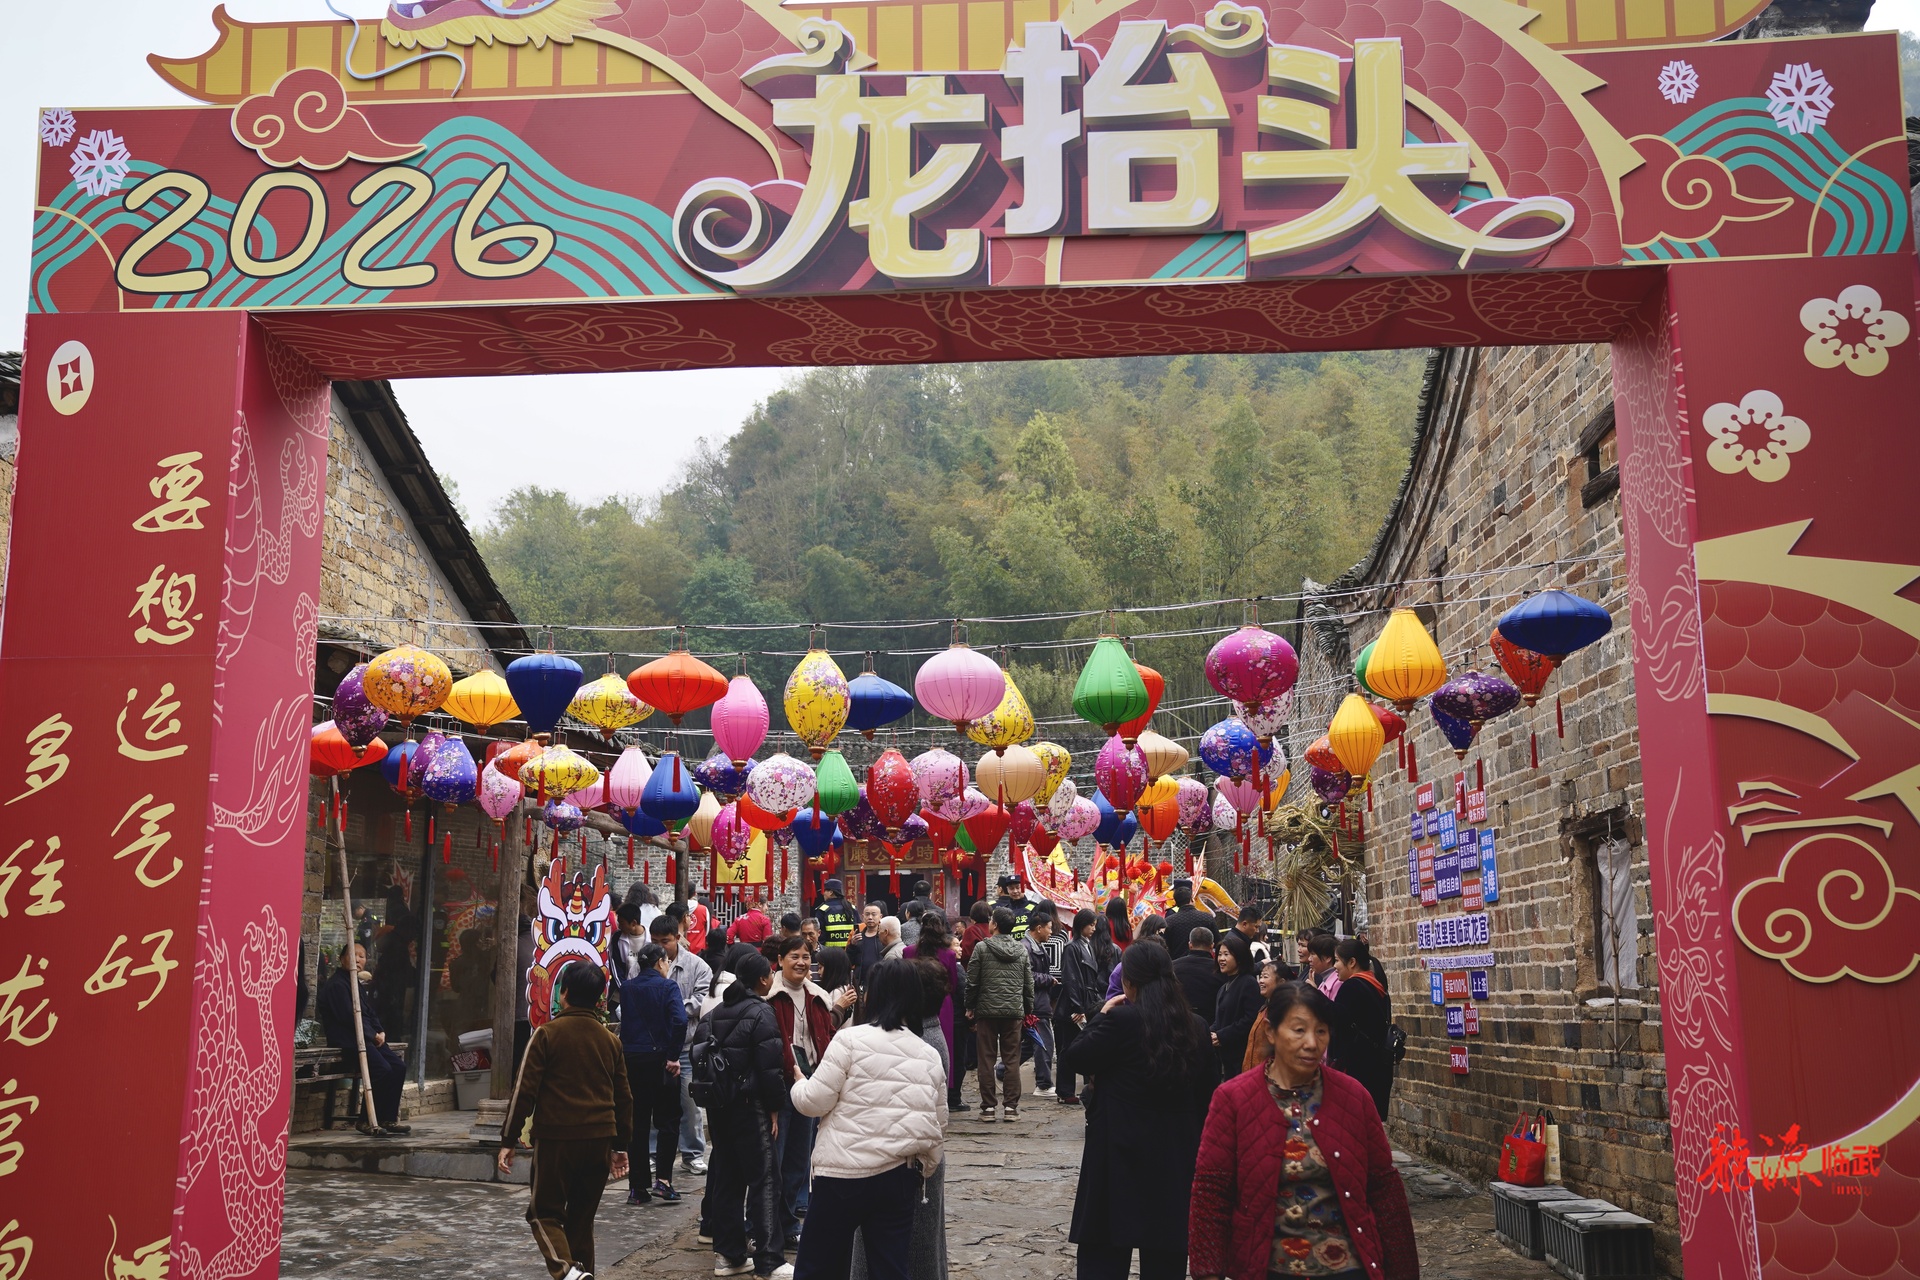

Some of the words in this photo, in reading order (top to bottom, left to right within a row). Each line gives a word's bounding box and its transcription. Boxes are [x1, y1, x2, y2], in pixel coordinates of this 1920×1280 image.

[672, 2, 1576, 292] 龙抬头
[115, 162, 557, 293] 2026
[84, 451, 211, 1011] 要想运气好
[1468, 808, 1485, 823] 快乐万岁
[1472, 978, 1487, 992] 上上签
[1466, 1009, 1477, 1020] GOOD
[1466, 1021, 1477, 1032] LUCK
